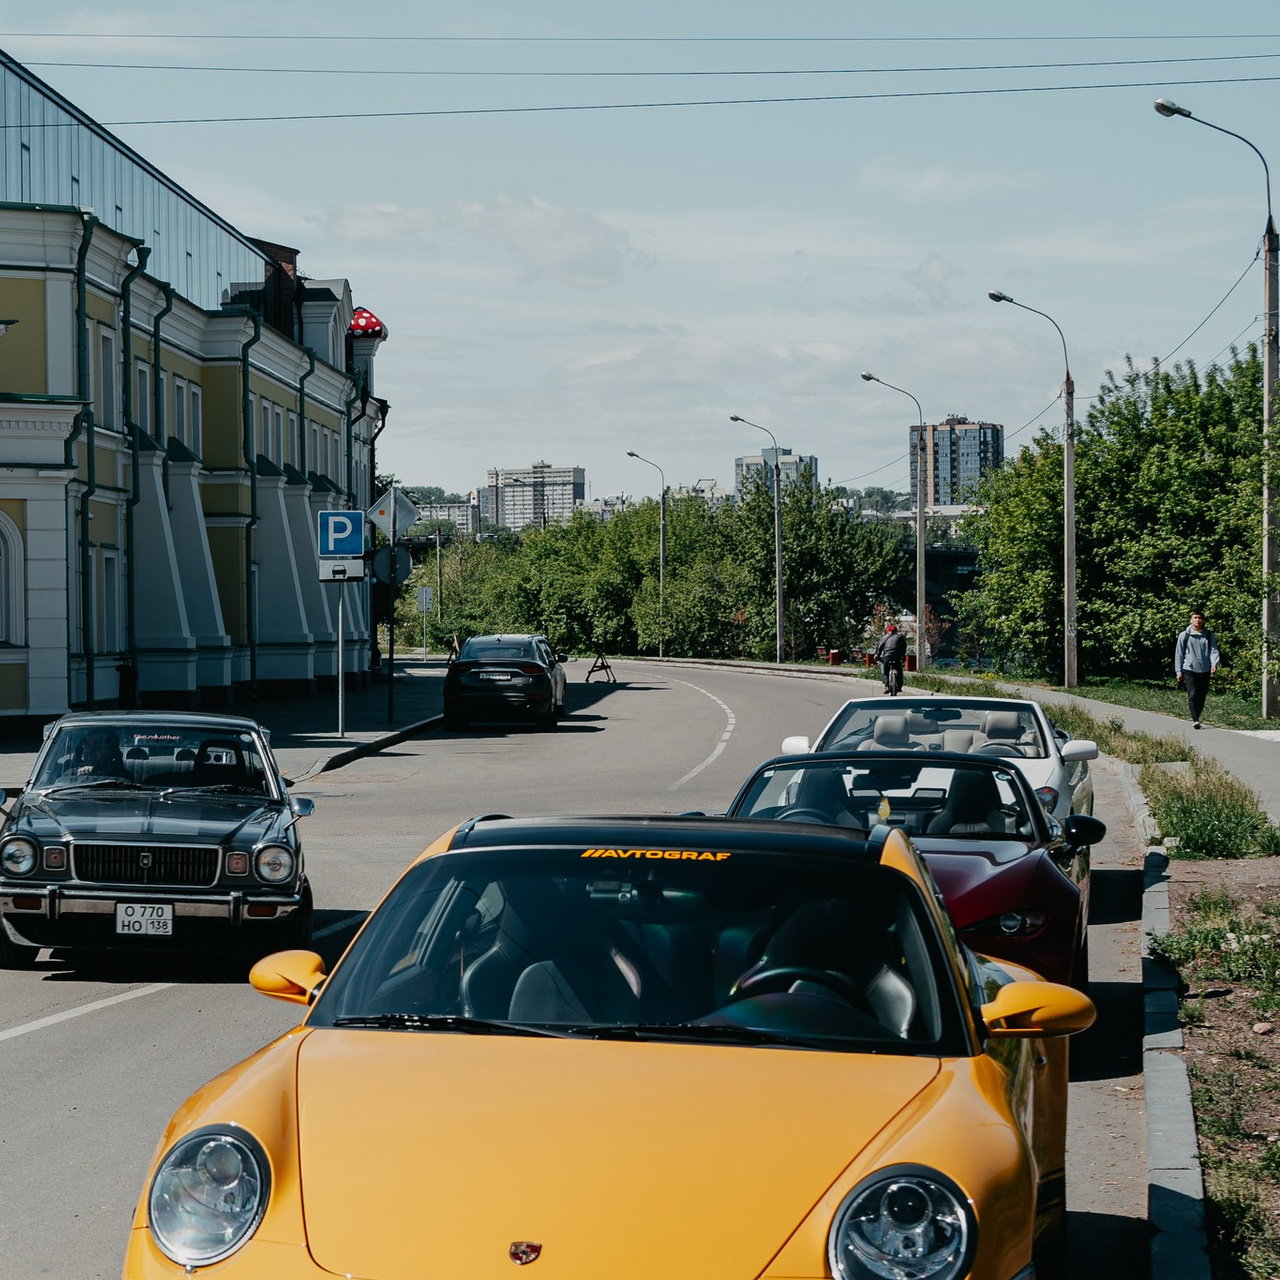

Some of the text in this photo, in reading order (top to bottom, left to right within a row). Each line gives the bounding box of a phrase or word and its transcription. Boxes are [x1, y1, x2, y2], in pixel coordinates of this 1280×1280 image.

[328, 516, 353, 551] P
[139, 906, 164, 918] 770
[149, 920, 168, 930] 138
